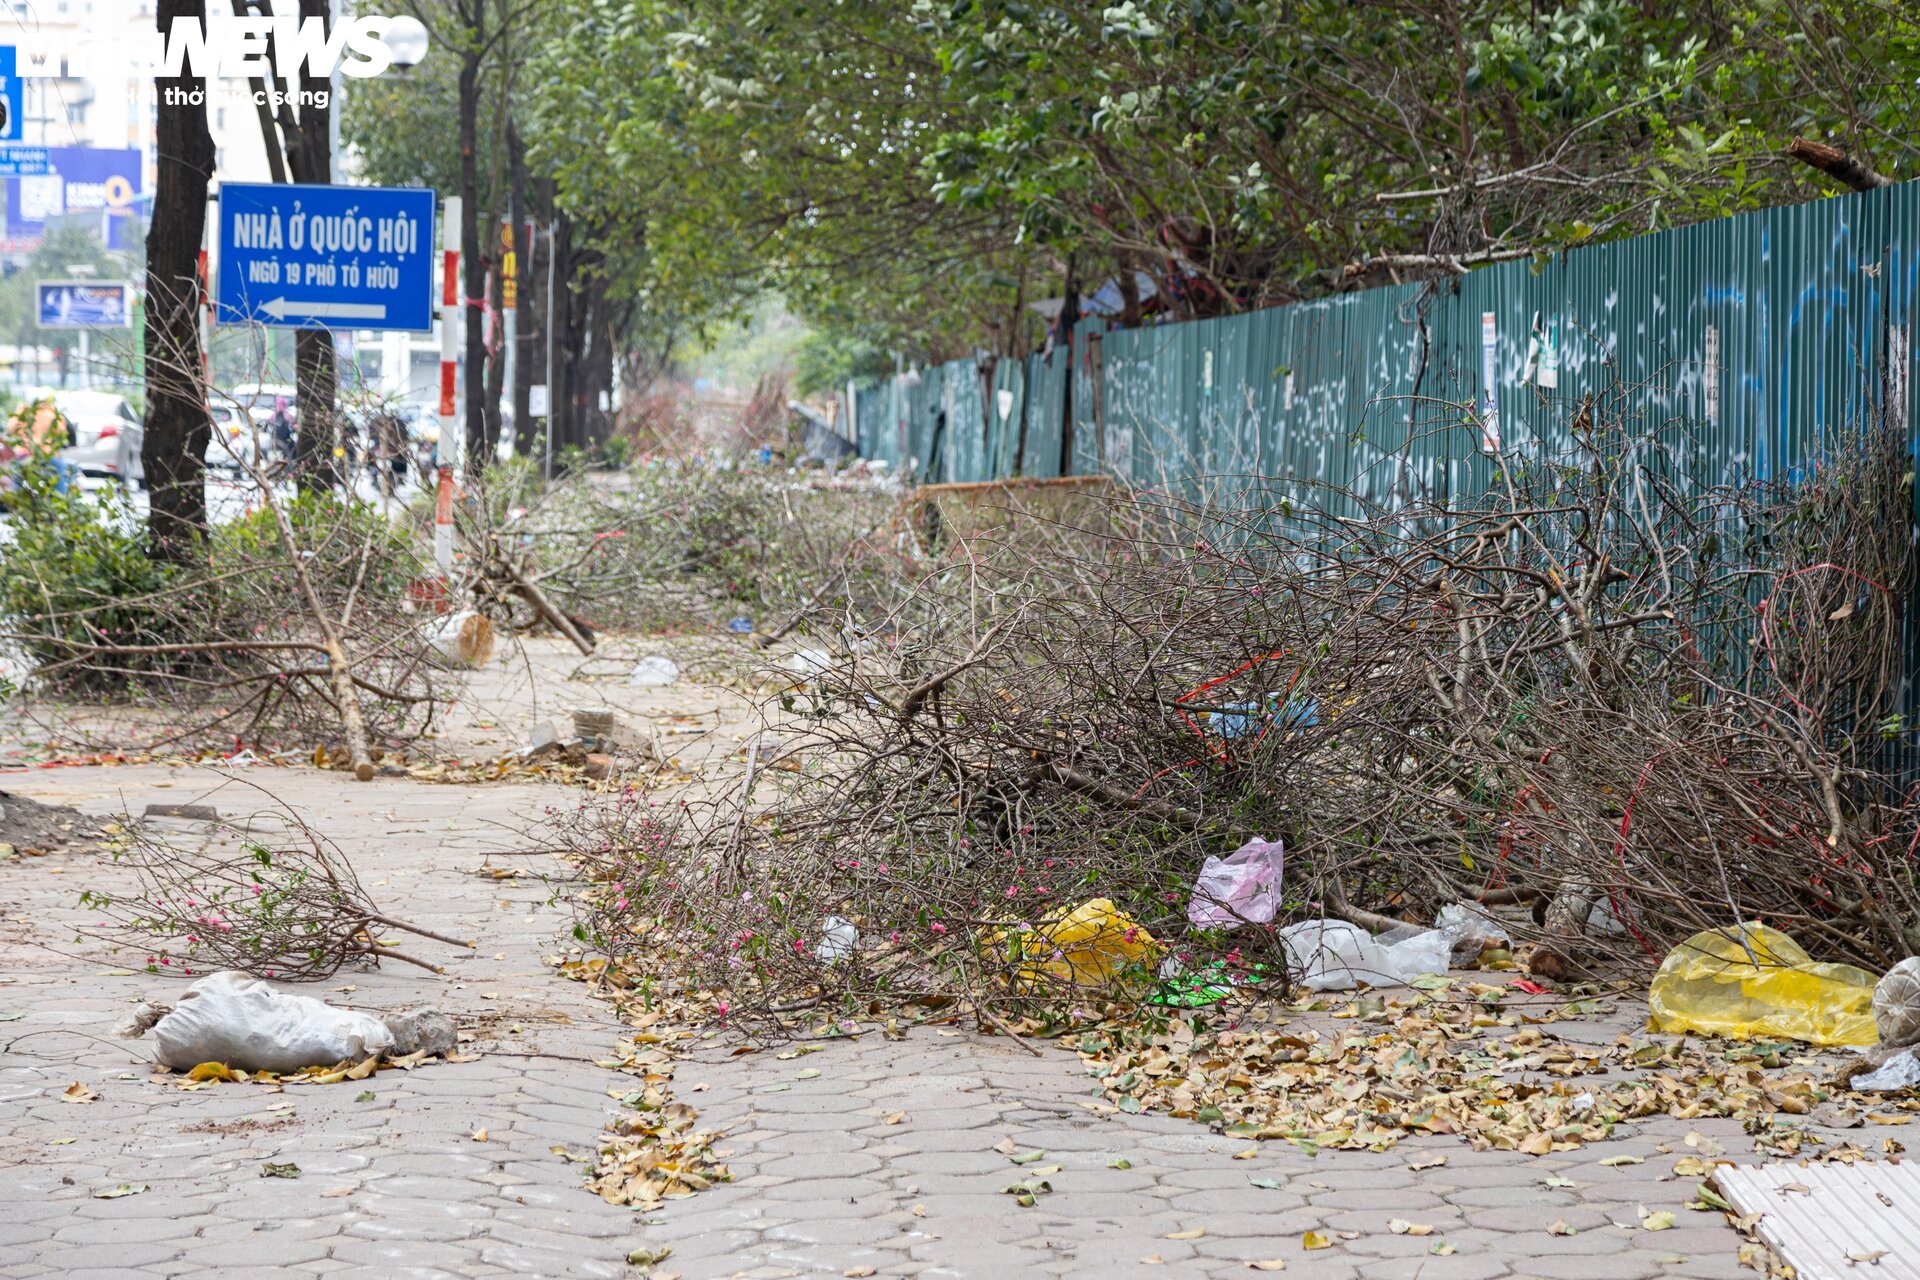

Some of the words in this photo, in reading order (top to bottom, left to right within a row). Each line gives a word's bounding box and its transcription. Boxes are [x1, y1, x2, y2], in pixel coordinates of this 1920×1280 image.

[234, 206, 283, 250] NHÀ
[289, 200, 306, 250] Ở
[310, 206, 373, 255] QUỐC
[378, 210, 418, 262] HỘI
[285, 262, 300, 285] 19
[305, 255, 336, 287] PHỐ
[341, 256, 360, 288] TỐ
[366, 260, 399, 289] HỮU
